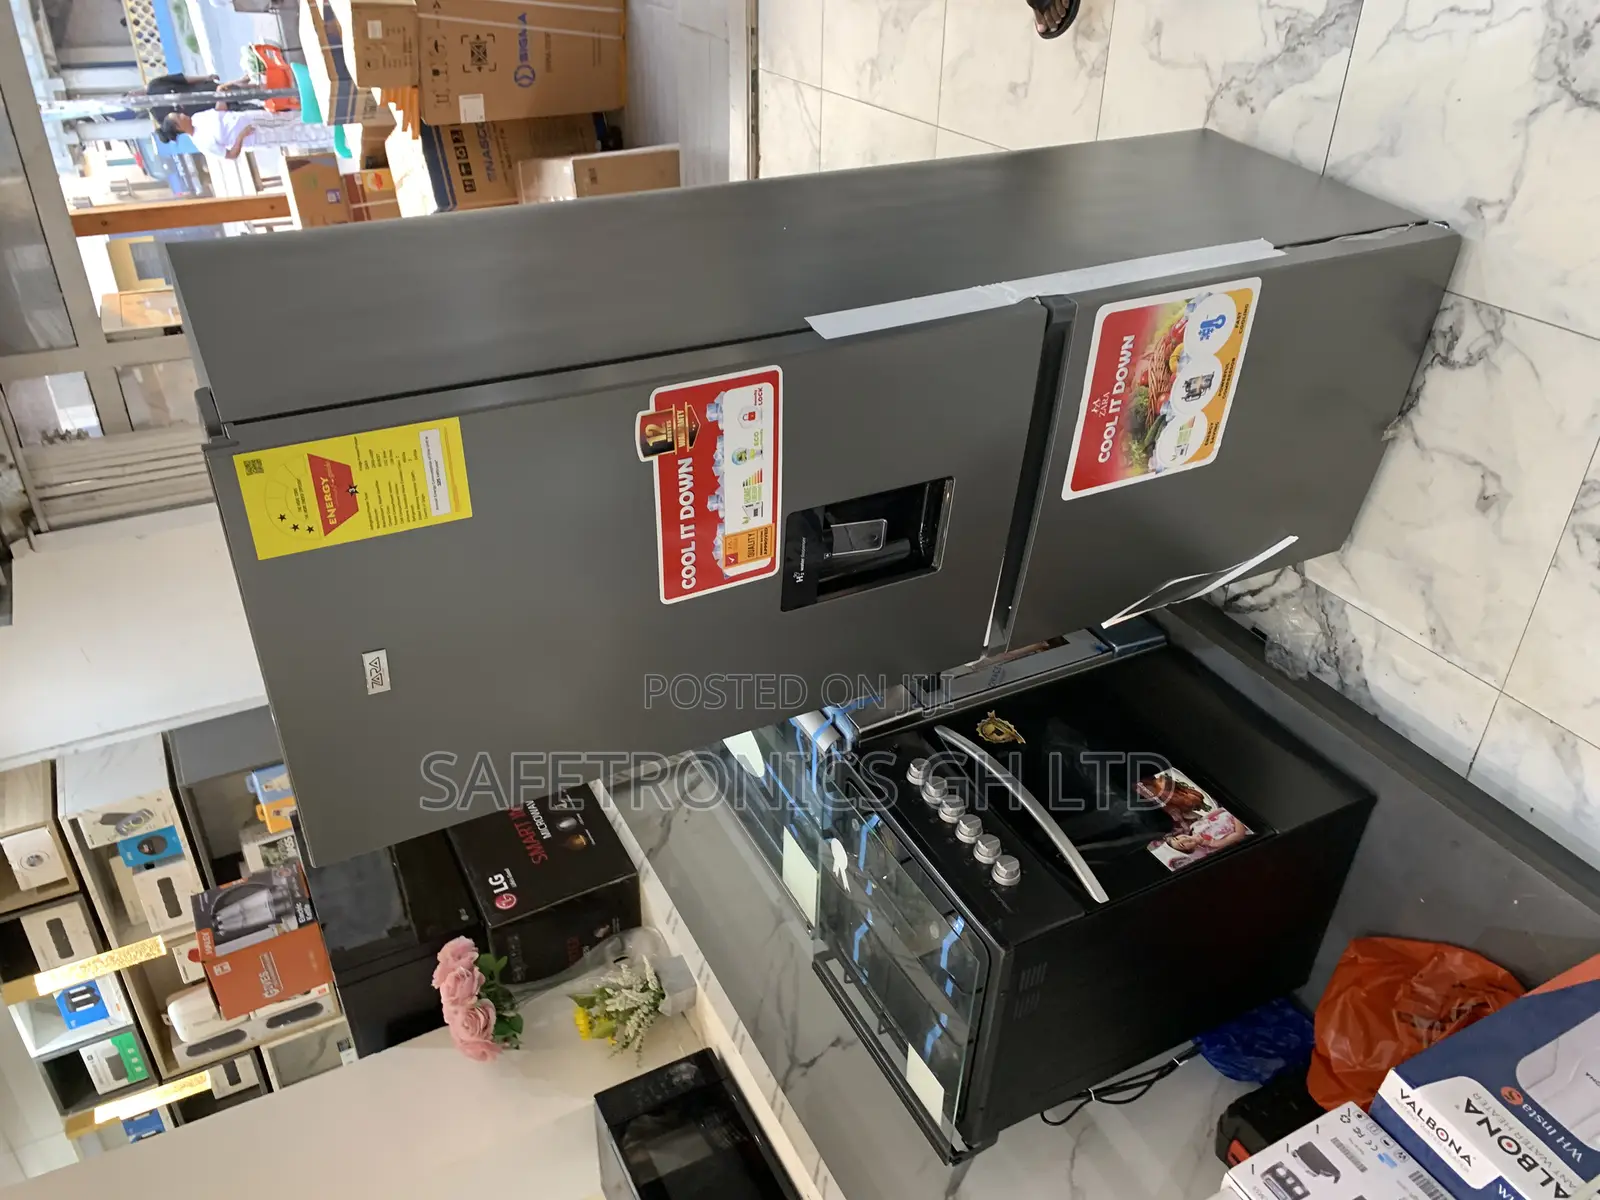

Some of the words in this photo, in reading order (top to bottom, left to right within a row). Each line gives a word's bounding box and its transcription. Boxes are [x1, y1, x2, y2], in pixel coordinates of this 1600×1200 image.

[1234, 311, 1242, 329] FAST
[1238, 303, 1250, 334] COOLING
[1112, 334, 1136, 394] DOWN
[1217, 362, 1230, 397] POWERFUL
[1221, 357, 1236, 400] COMPRESSOR
[1099, 391, 1110, 417] ZARA
[1108, 398, 1123, 414] IT
[645, 423, 667, 448] 12
[676, 409, 686, 448] WARRANTY
[1097, 416, 1120, 463] COOL
[1204, 422, 1214, 446] ENERGY
[1209, 421, 1220, 444] SAVING
[320, 477, 338, 525] ENERGY
[677, 457, 696, 519] DOWN
[680, 523, 696, 540] IT
[748, 532, 756, 558] QUALITY
[680, 541, 697, 590] COOL
[524, 800, 552, 840] MICROWAV
[514, 822, 548, 864] SMART
[488, 873, 509, 894] LG
[295, 902, 306, 923] Electric
[302, 904, 313, 920] Kettle
[1400, 1088, 1472, 1167] VALBONA
[1472, 1092, 1516, 1131] HEATER
[1521, 1102, 1557, 1136] Insta
[1464, 1097, 1572, 1200] ALBONA
[1515, 1132, 1552, 1168] WATER
[1555, 1136, 1583, 1163] WH
